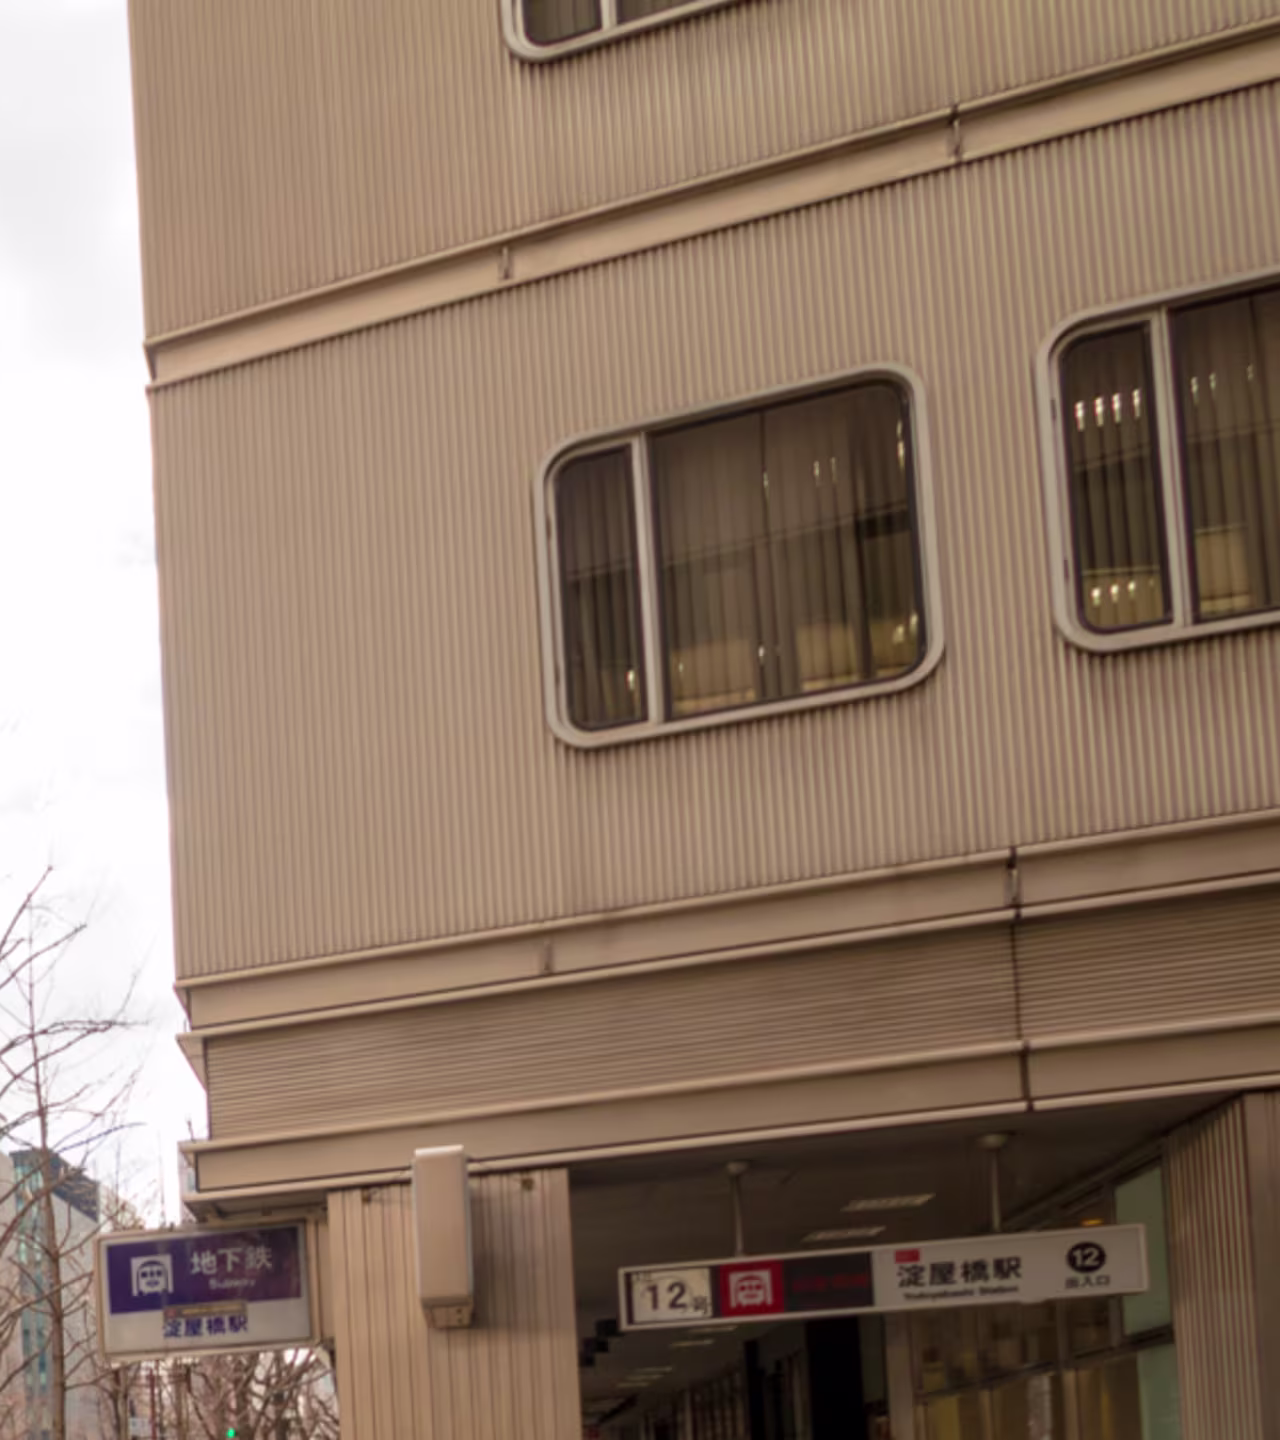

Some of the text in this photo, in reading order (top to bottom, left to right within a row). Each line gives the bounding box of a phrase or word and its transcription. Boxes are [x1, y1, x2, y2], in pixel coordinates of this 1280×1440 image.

[191, 1246, 273, 1275] 地下鉄
[1072, 1247, 1101, 1268] 12
[896, 1257, 1022, 1288] 淀屋橋駅
[163, 1315, 248, 1338] 淀屋橋駅
